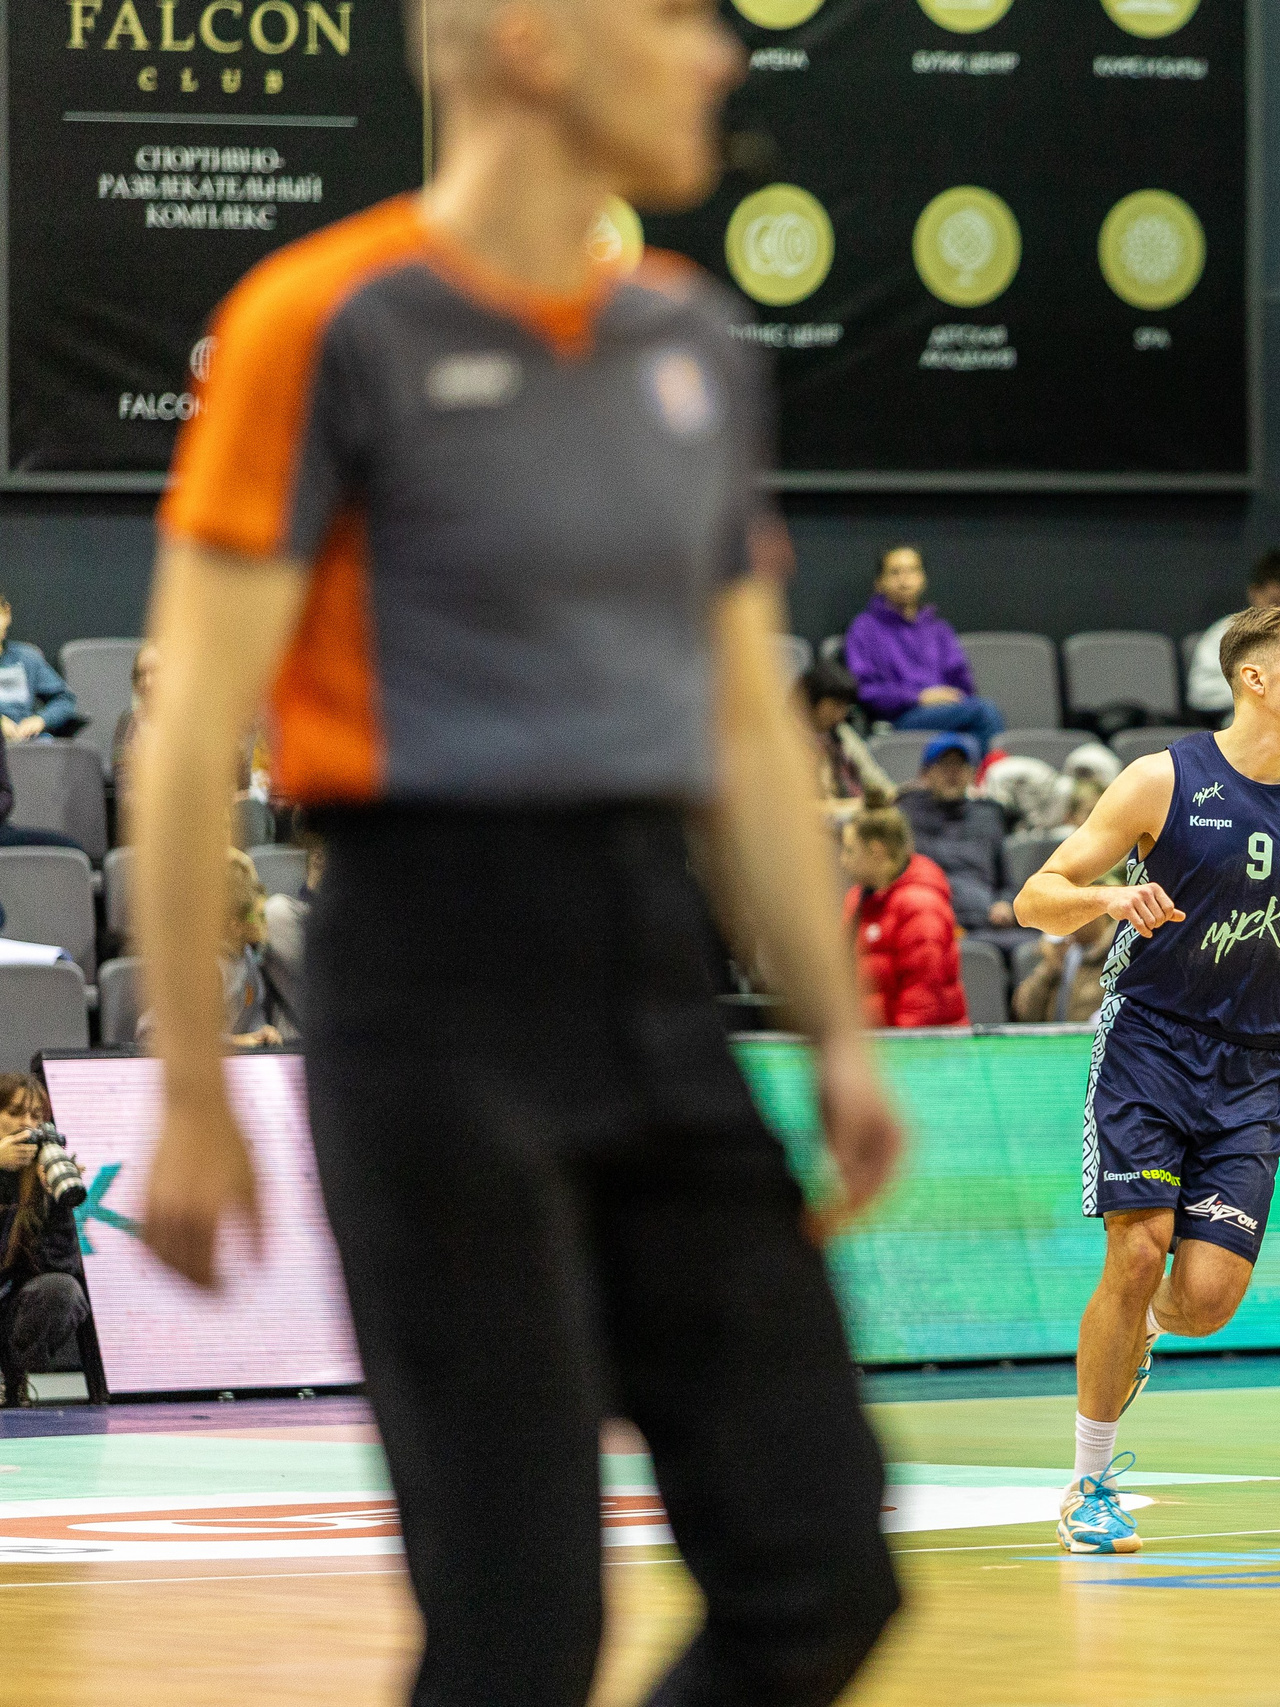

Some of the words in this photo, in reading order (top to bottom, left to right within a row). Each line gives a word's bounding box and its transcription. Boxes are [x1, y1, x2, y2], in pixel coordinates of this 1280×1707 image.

[66, 1, 353, 56] FALCON
[137, 65, 284, 94] CLUB
[135, 144, 285, 173] СПОРТИВНО-
[98, 173, 323, 203] РАЗВЛЕКАТЕЛЬНЫЙ
[145, 201, 278, 231] КОМПЛЕКС
[1189, 815, 1233, 830] Kempa
[1246, 831, 1273, 880] 9
